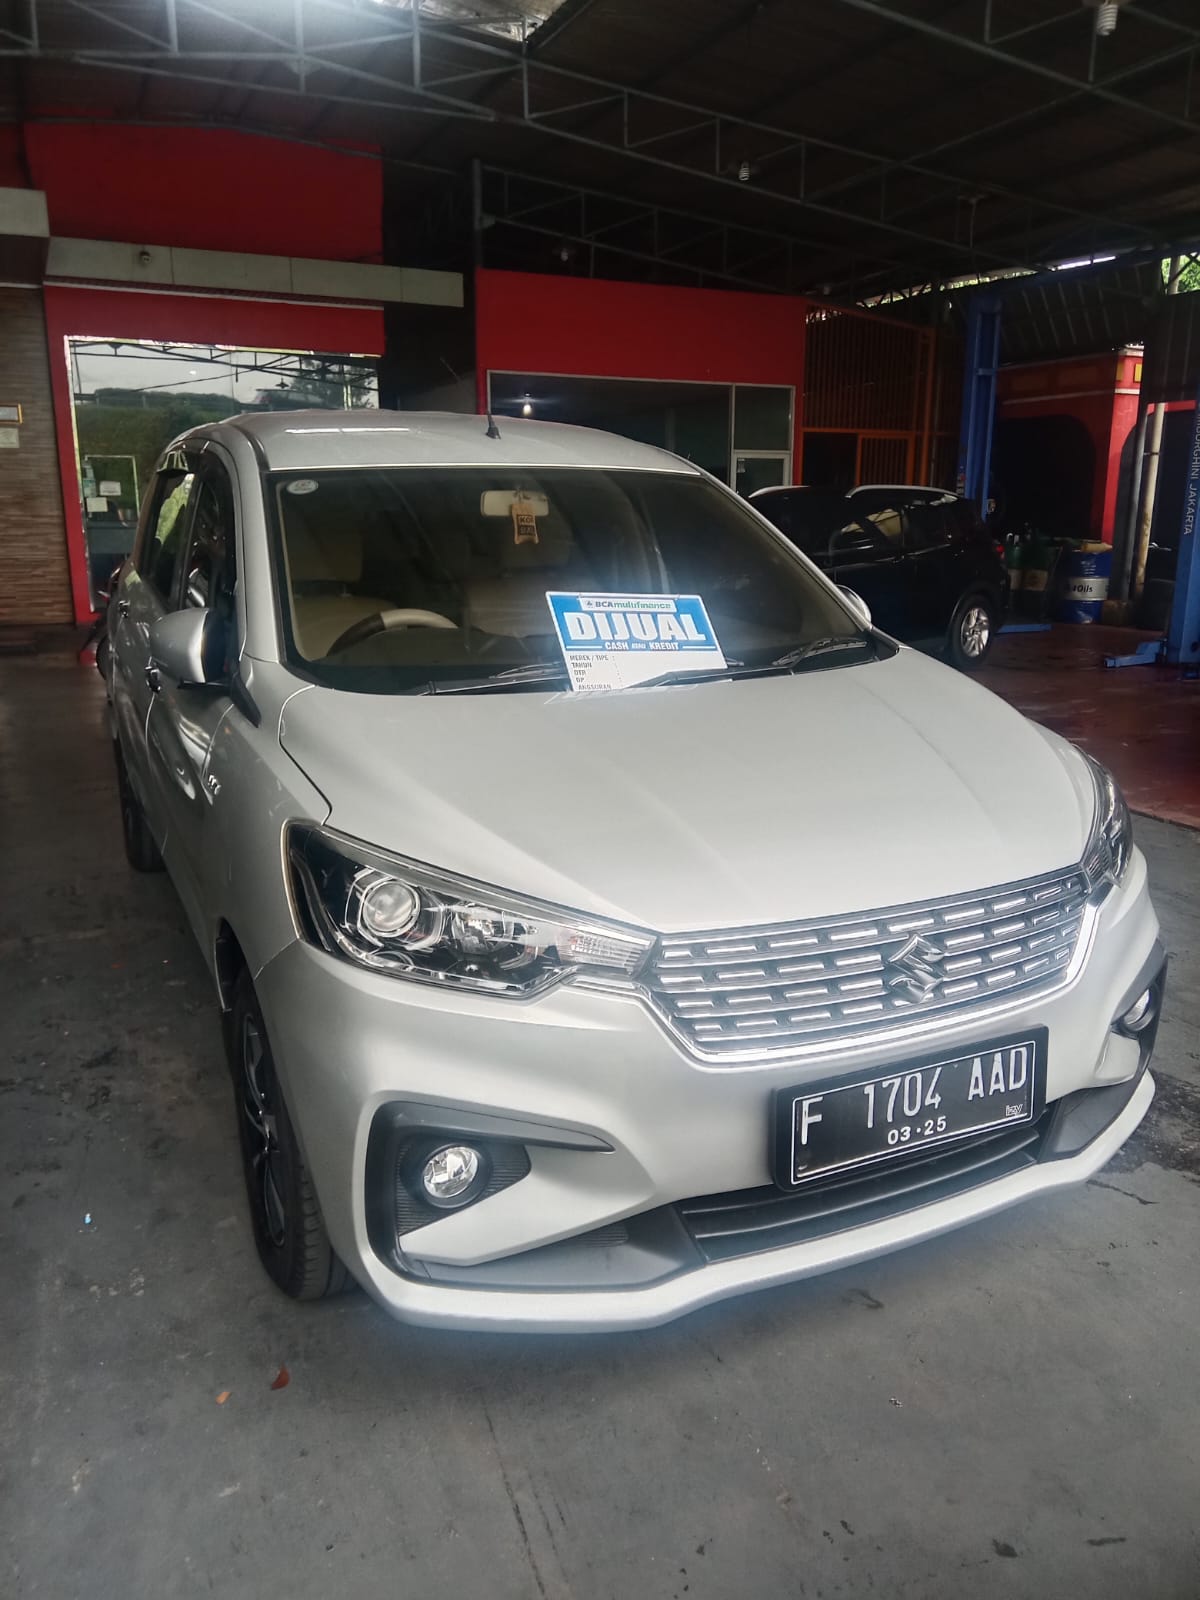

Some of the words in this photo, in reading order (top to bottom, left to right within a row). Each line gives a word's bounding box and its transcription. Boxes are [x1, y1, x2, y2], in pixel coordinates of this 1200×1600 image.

[1183, 483, 1198, 535] JAKARTA
[563, 612, 706, 641] DIJUAL
[604, 641, 629, 650] CASH
[649, 641, 679, 651] KREDIT
[801, 1096, 823, 1145] F
[864, 1066, 942, 1128] 1704
[967, 1046, 1028, 1101] AAD
